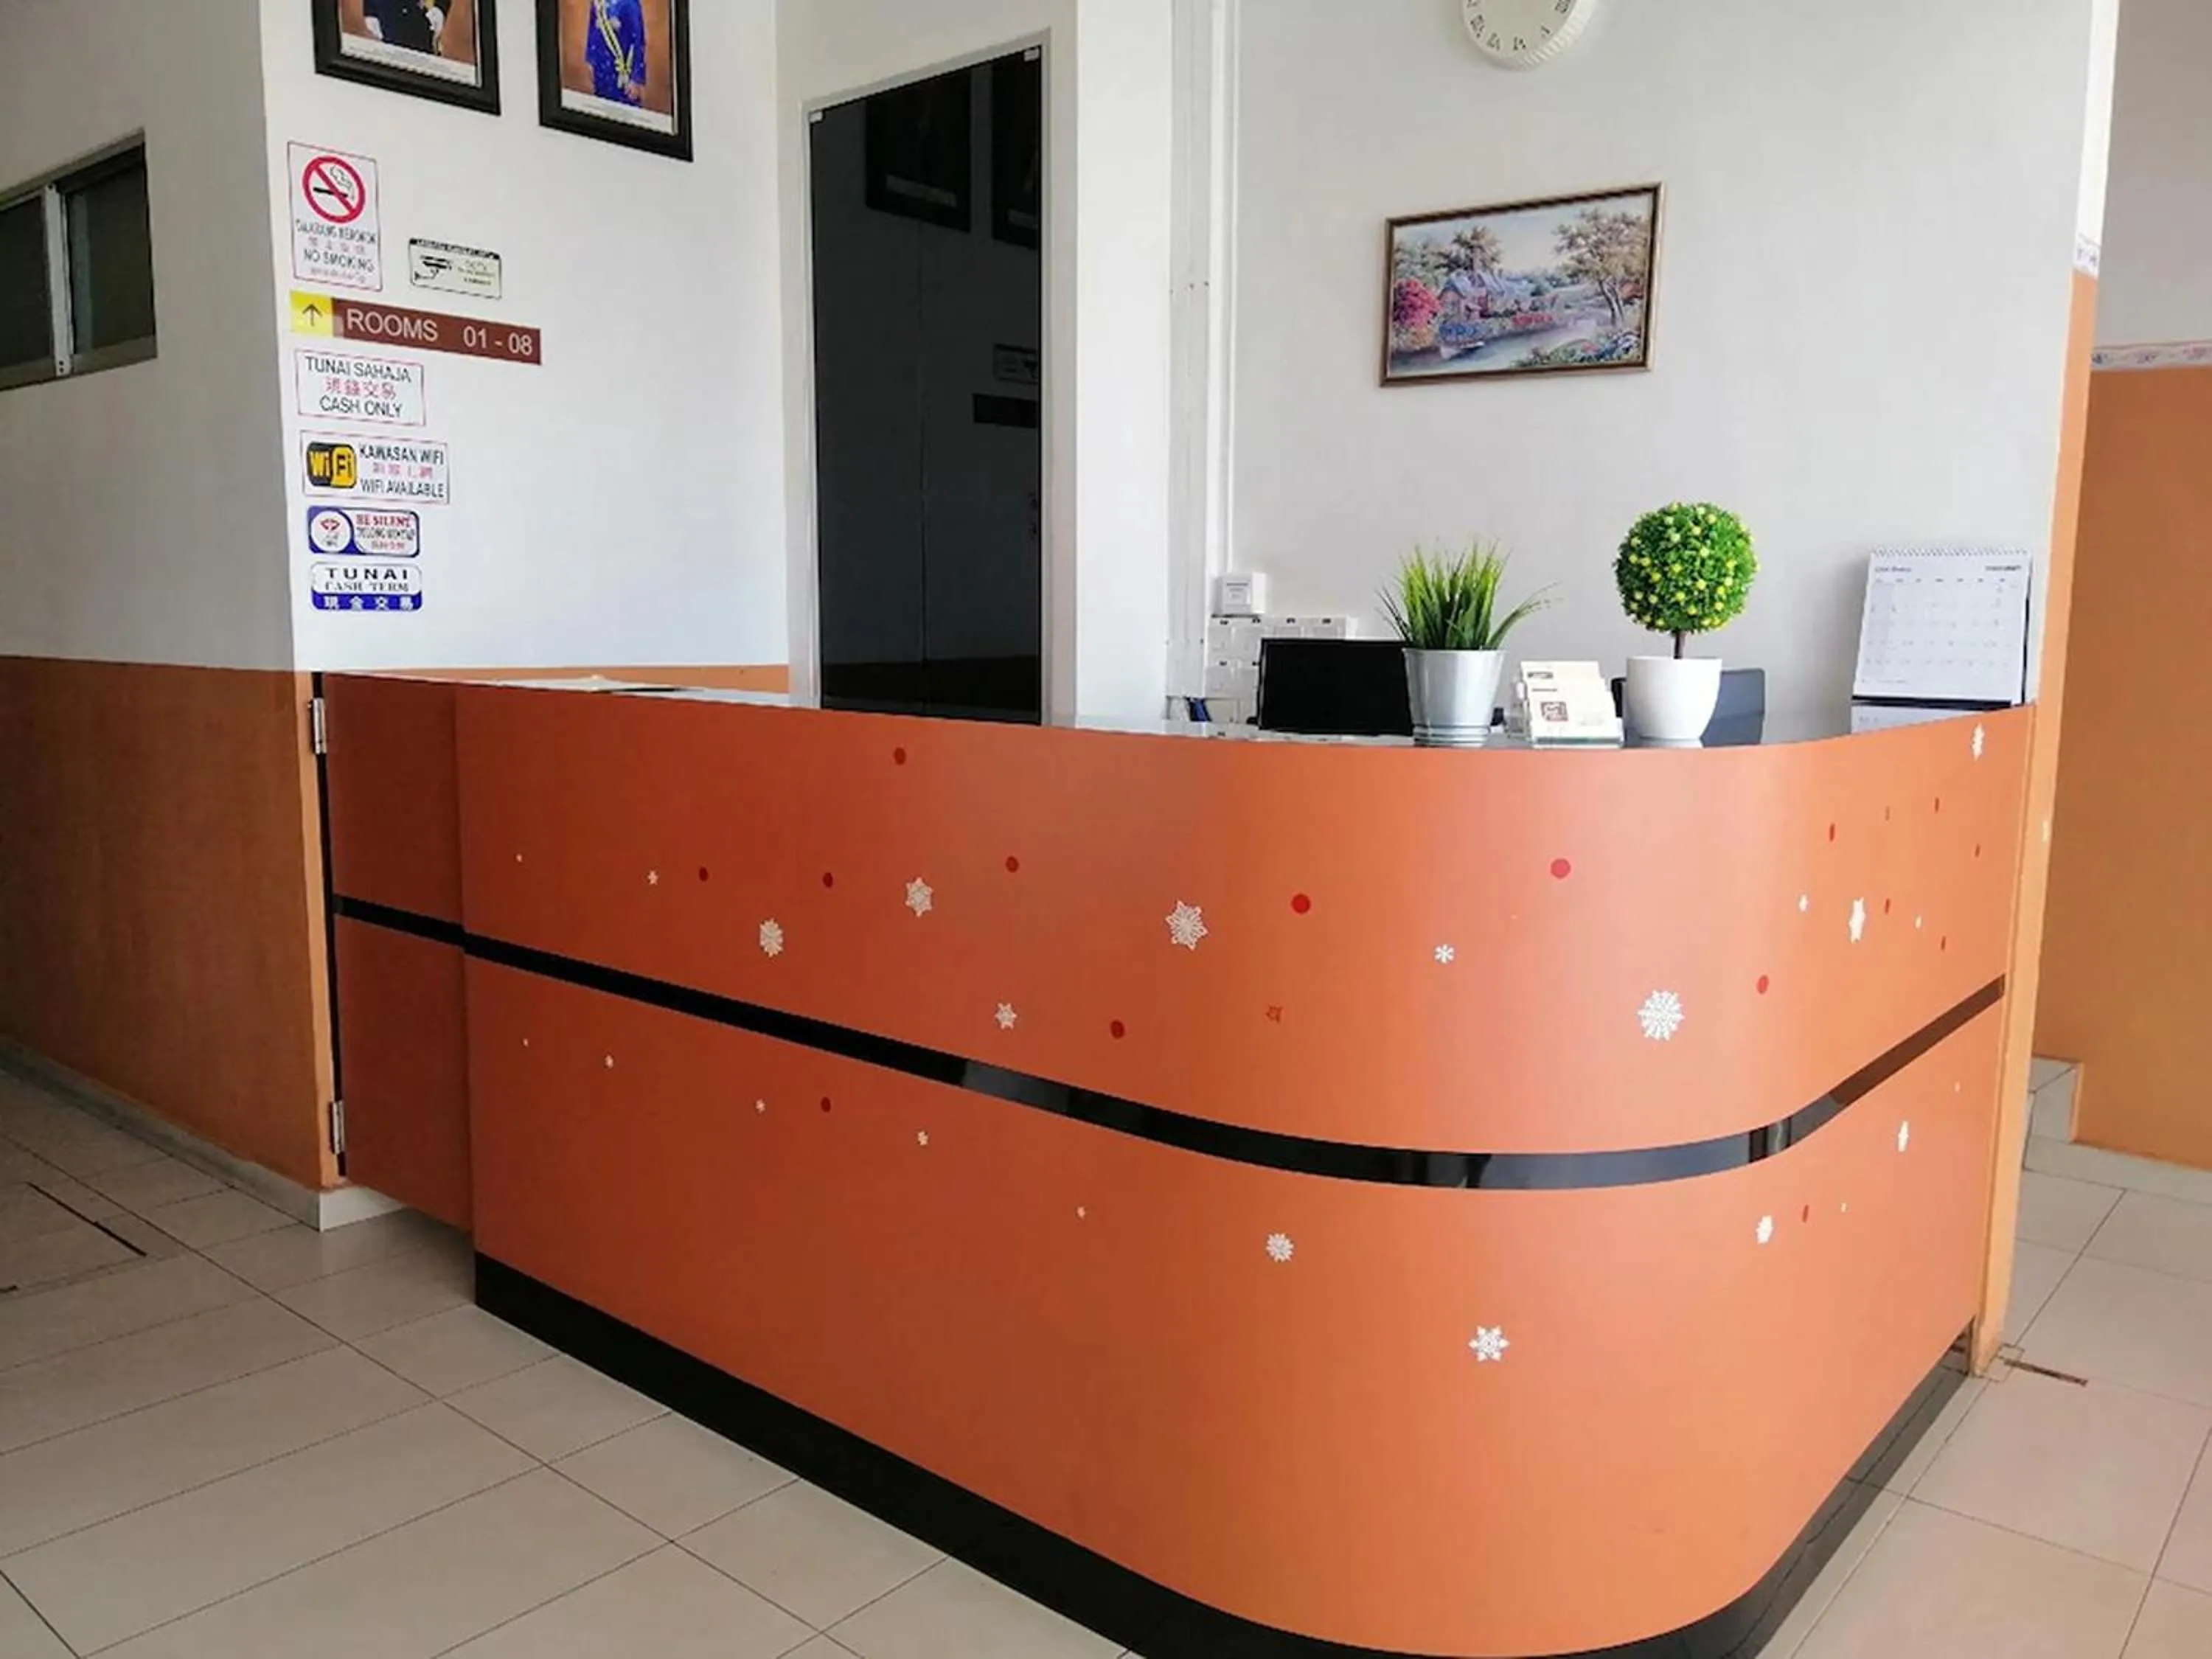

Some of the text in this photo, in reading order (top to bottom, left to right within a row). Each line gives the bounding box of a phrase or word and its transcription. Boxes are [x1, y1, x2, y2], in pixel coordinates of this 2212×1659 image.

[304, 248, 375, 273] NO SMOKING
[347, 308, 439, 342] ROOMS
[463, 326, 487, 349] 01
[508, 334, 532, 355] 08
[305, 355, 411, 383] TUNAI SAHAJA
[319, 395, 402, 418] CASH ONLY
[359, 443, 444, 465] KAWASAN WIFI
[360, 479, 445, 498] WIFI AVAILABLE
[372, 515, 411, 527] SILENT
[325, 568, 408, 580] TUNAI
[325, 582, 408, 591] CASH TERM
